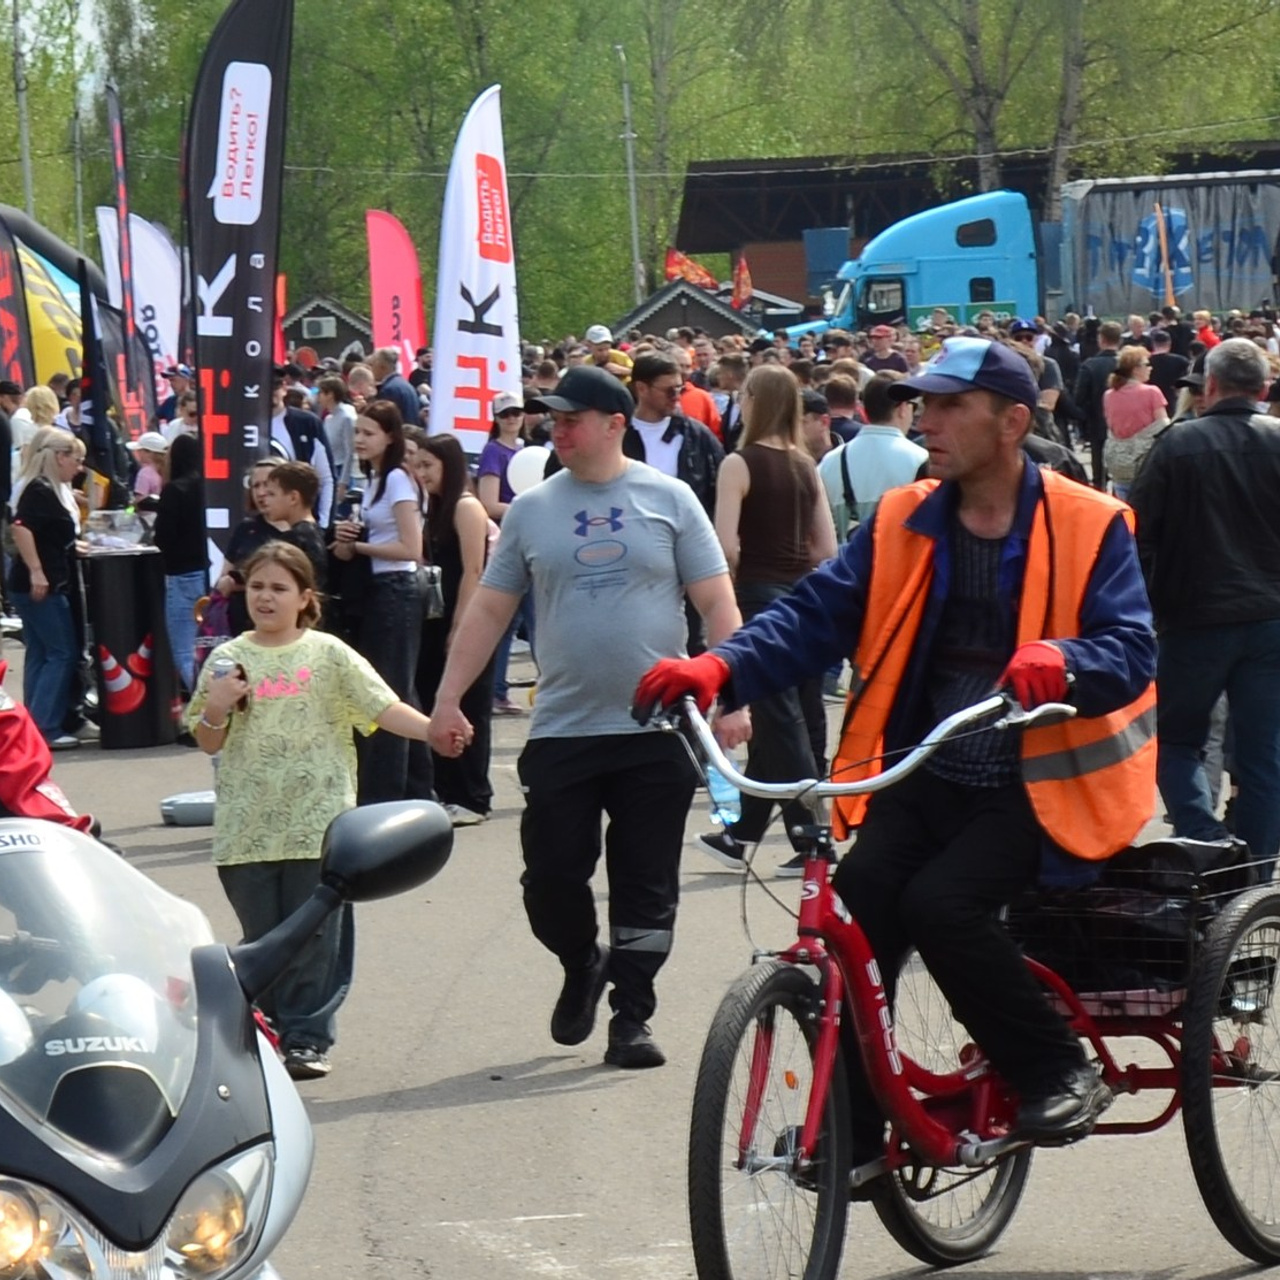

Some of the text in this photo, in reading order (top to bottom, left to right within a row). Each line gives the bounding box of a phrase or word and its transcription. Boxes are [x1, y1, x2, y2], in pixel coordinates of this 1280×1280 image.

[222, 87, 242, 198] Водить?
[240, 113, 259, 200] Легко!
[44, 1036, 151, 1056] SUZUKI
